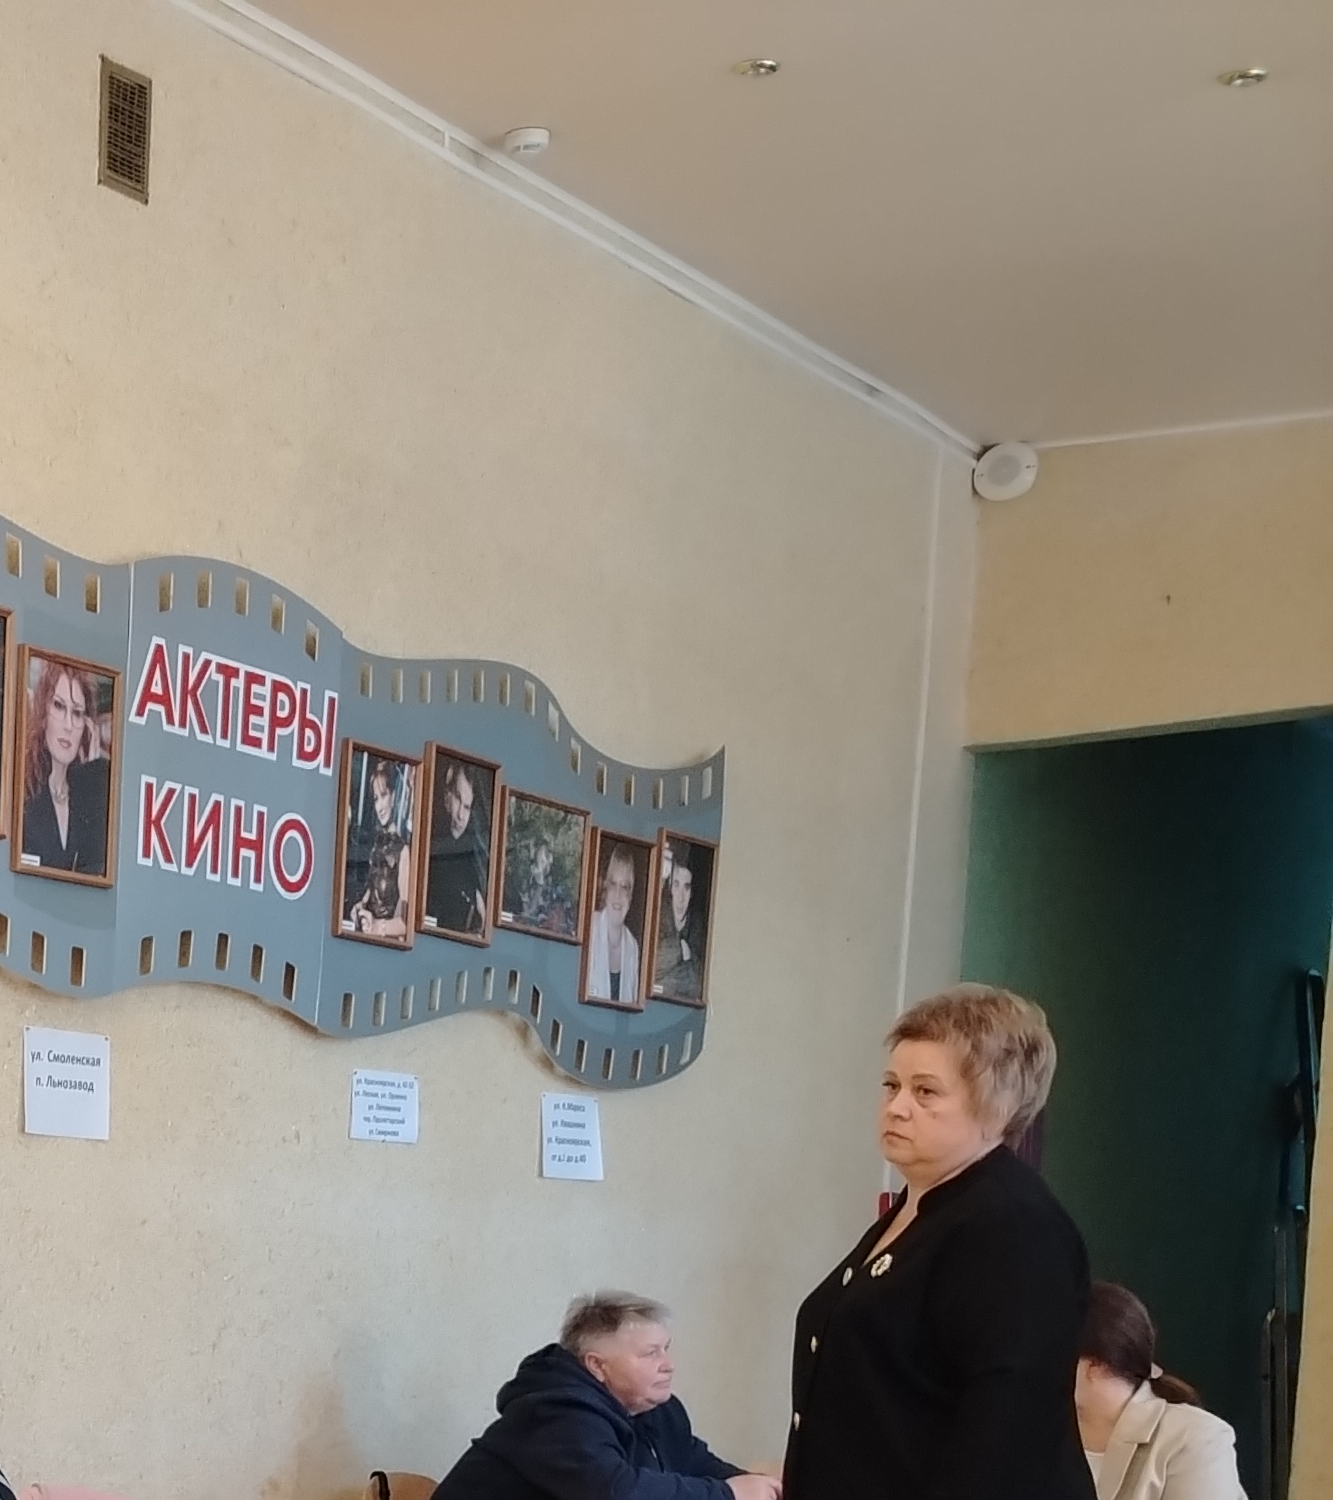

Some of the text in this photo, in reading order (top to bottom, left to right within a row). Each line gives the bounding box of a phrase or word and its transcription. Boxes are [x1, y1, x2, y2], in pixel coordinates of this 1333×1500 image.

[131, 638, 337, 773] АКТЕРЫ
[138, 776, 314, 899] КИНО
[30, 1049, 102, 1068] ул. Смоленская
[35, 1075, 95, 1094] п. Льнозавод
